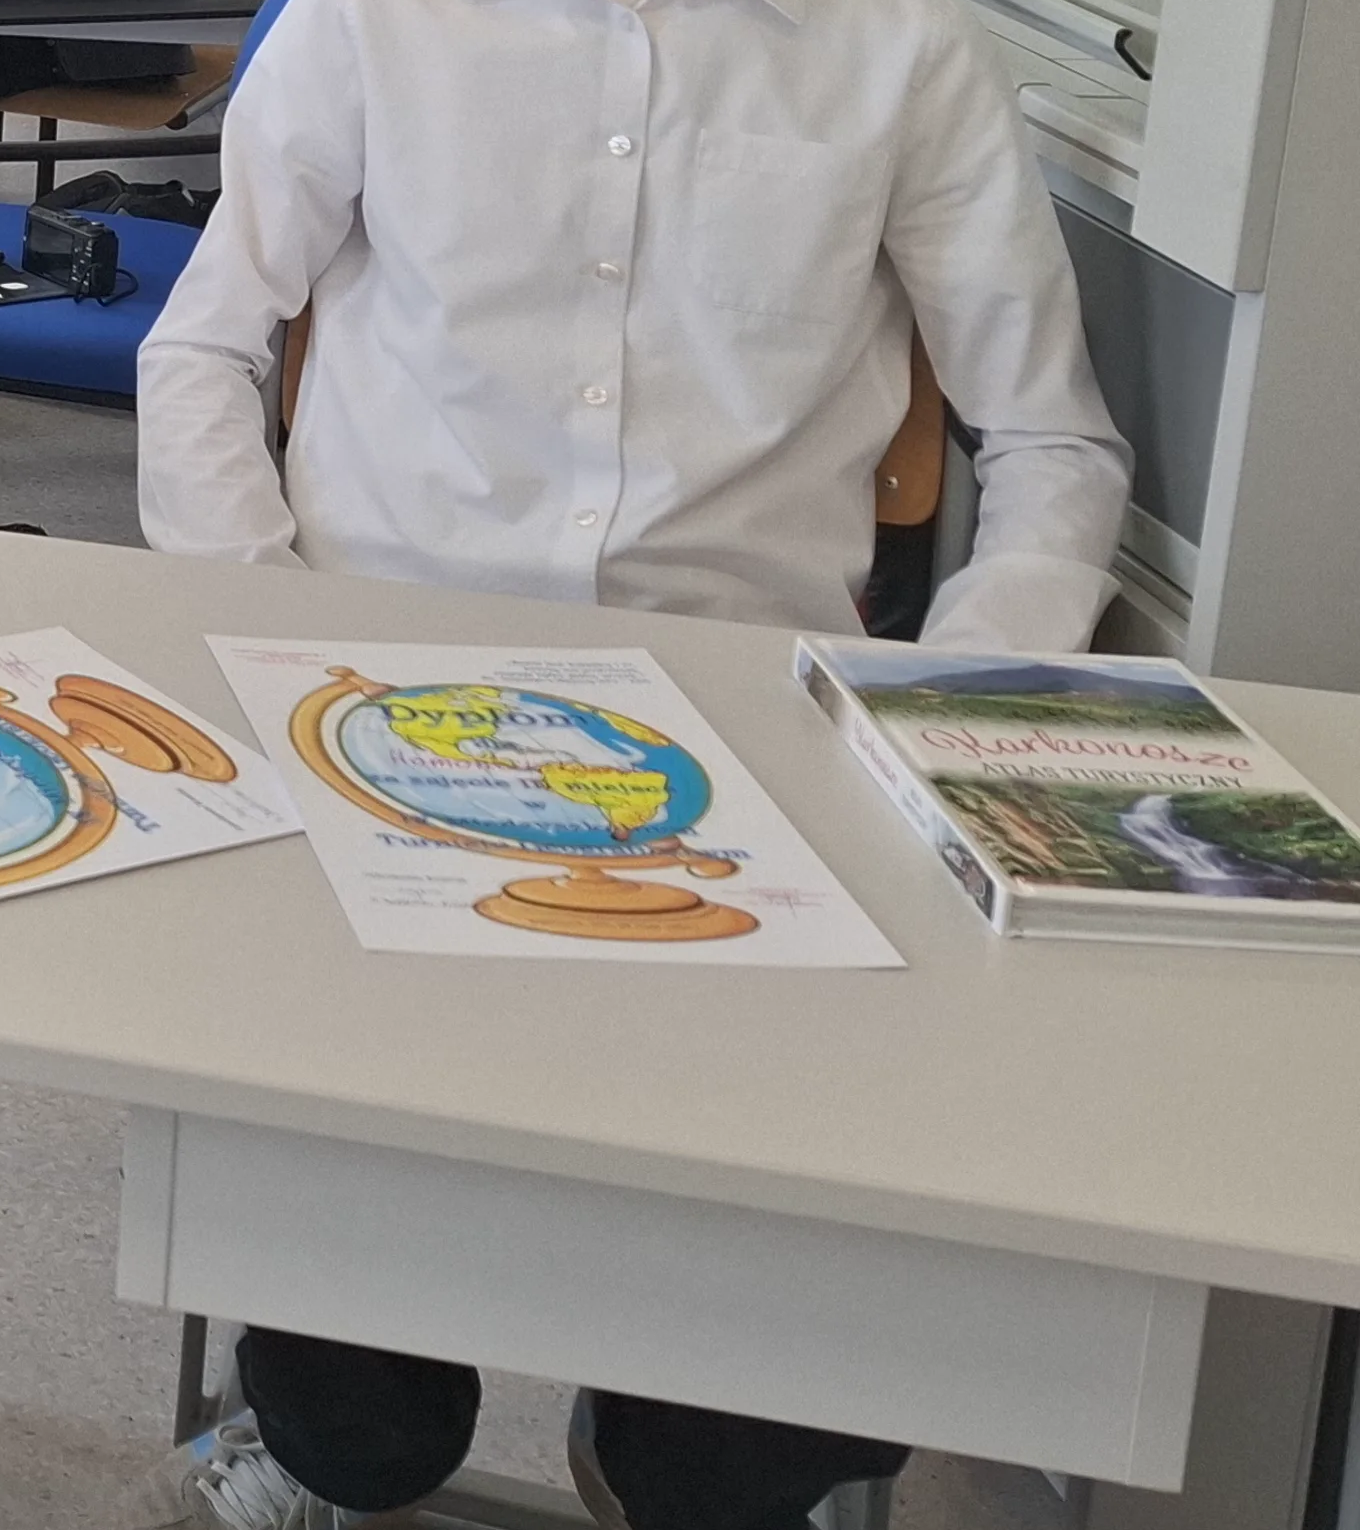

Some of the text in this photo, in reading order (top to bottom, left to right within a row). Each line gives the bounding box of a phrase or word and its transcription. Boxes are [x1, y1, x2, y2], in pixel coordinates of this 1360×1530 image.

[375, 703, 595, 733] Dyplom
[920, 726, 1252, 772] Karkonosze
[980, 761, 1245, 790] ATLAS TURYSTYCZNY
